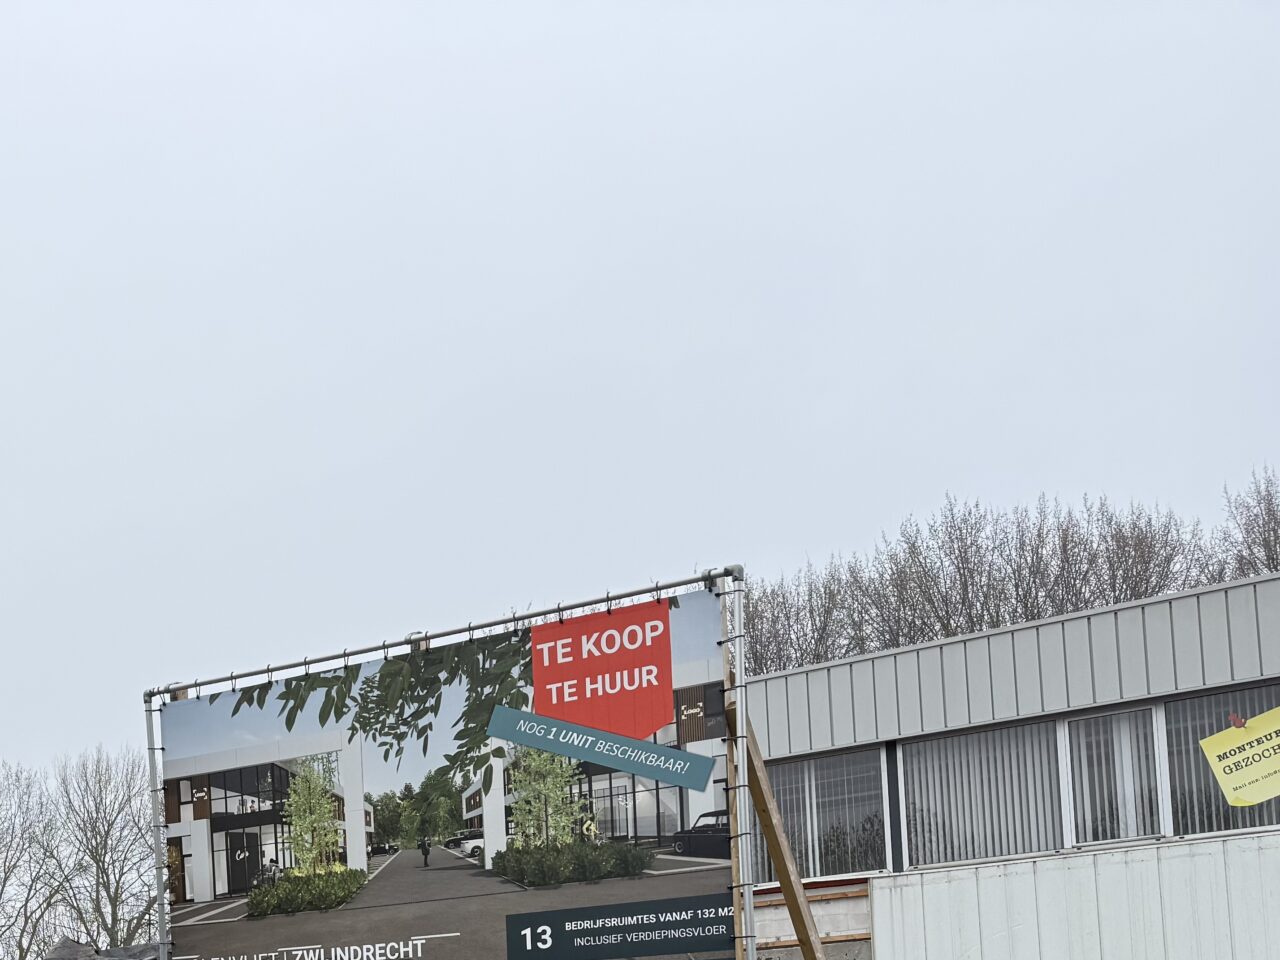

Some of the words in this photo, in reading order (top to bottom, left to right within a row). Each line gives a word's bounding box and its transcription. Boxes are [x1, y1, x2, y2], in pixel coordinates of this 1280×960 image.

[536, 638, 573, 667] TE
[581, 620, 664, 659] KOOP
[546, 680, 578, 705] TE
[585, 665, 658, 698] HUUR
[516, 719, 547, 737] NOG
[547, 727, 555, 740] 1
[559, 730, 596, 749] UNIT
[595, 740, 690, 774] BESCHIKBAAR!
[1232, 783, 1247, 792] Mail
[520, 925, 553, 950] 13
[565, 914, 656, 931] BEDRIJFSRUIMTES
[658, 910, 694, 923] VANAF
[697, 908, 716, 919] 132
[718, 906, 734, 917] M2
[574, 934, 623, 947] INCLUSIEF
[625, 925, 727, 942] VERDIEPINGSVLOER
